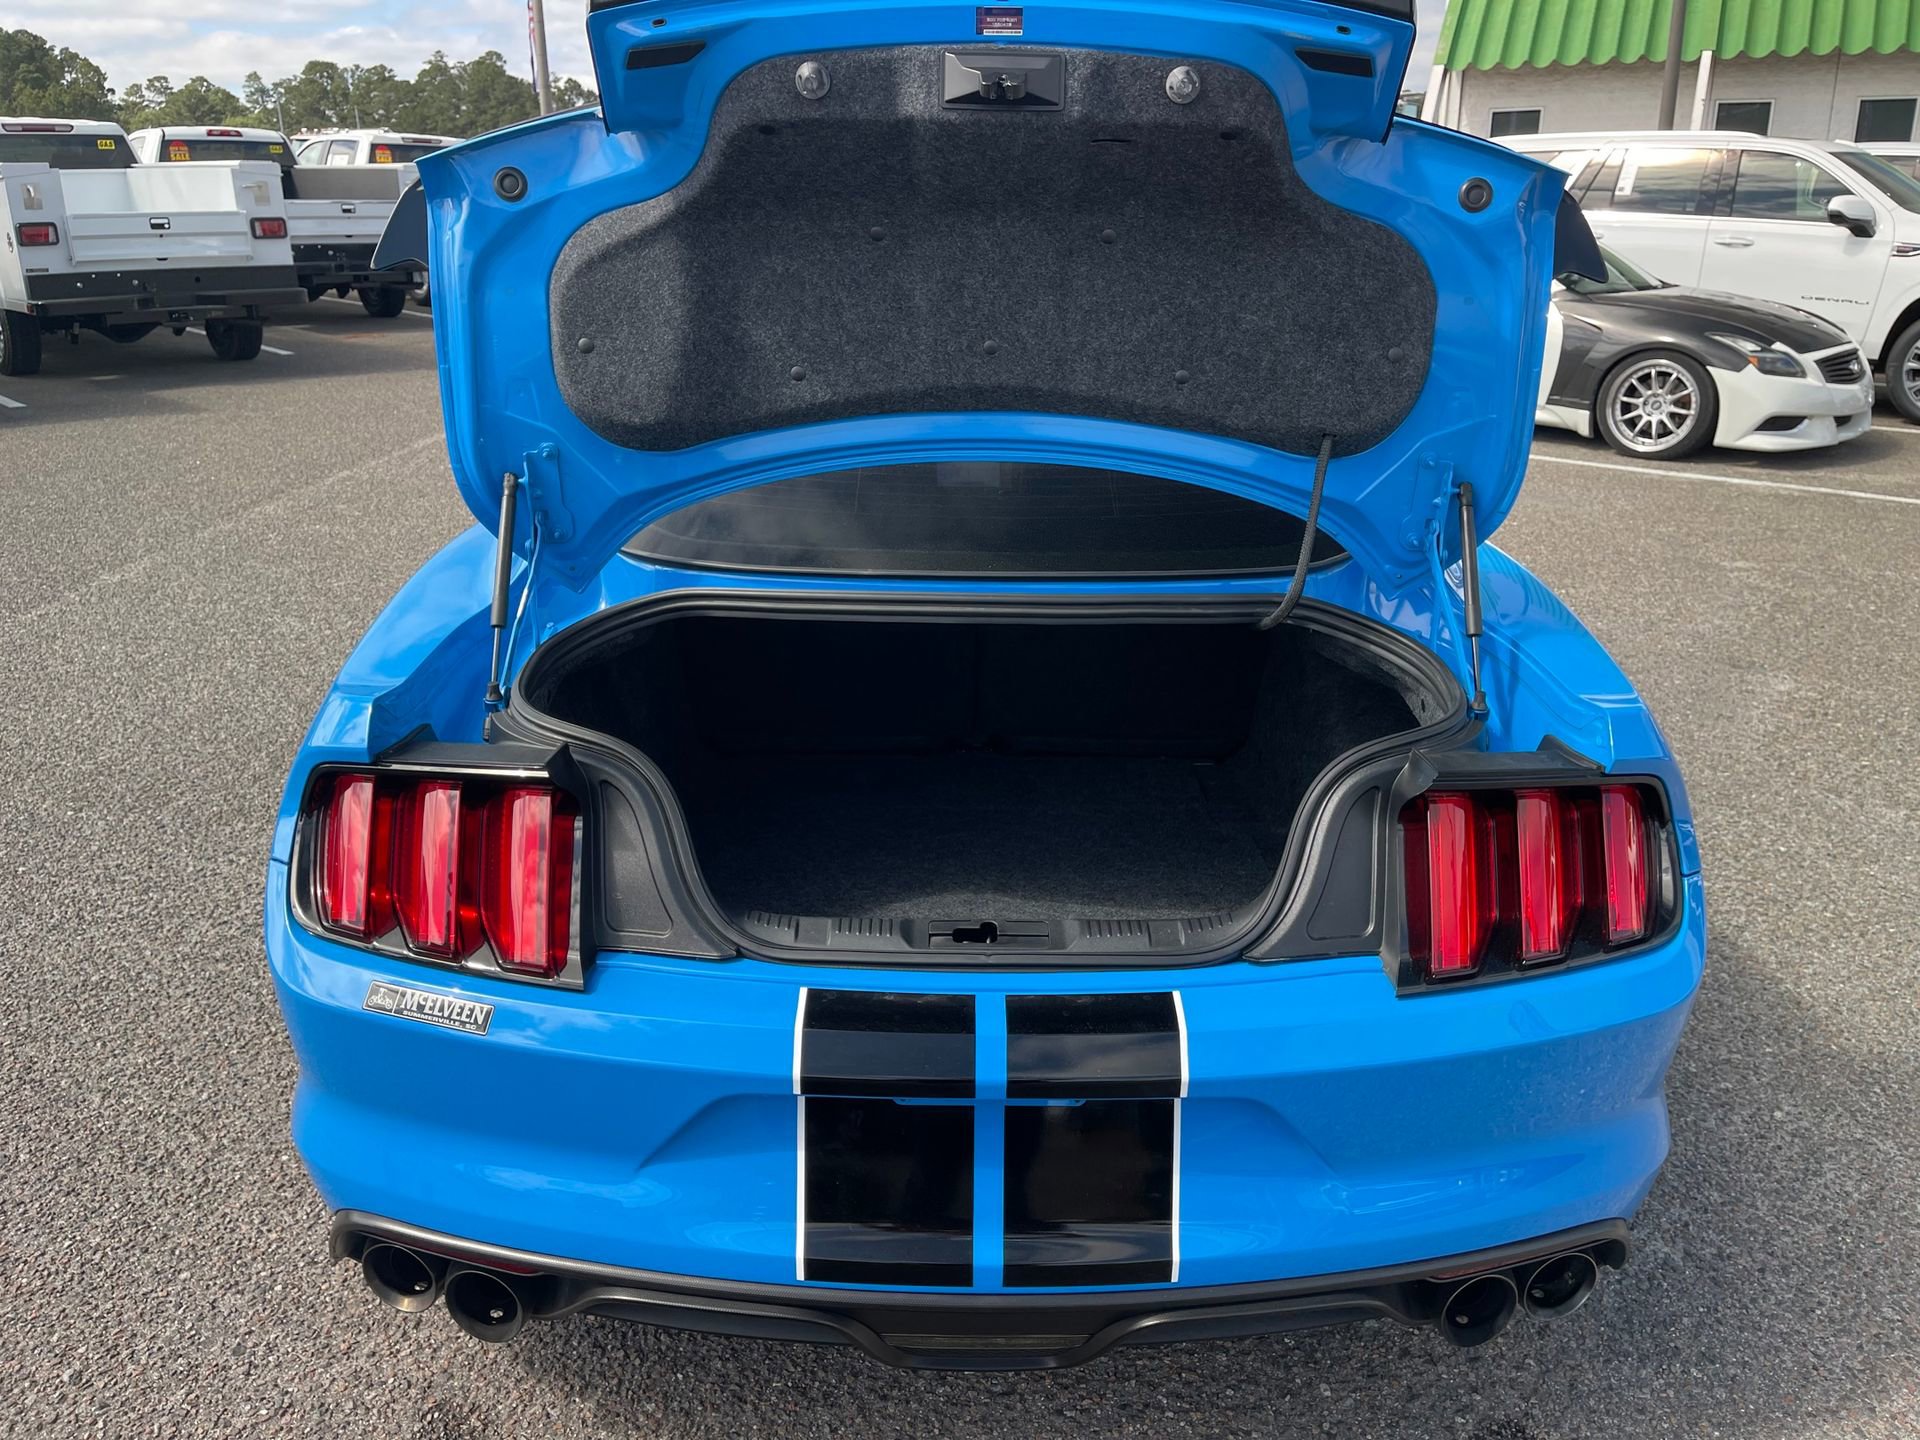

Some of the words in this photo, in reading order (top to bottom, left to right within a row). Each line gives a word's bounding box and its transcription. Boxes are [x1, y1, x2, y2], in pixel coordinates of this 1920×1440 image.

[1800, 295, 1870, 305] DENALI
[402, 1010, 464, 1028] SUMMERVILLE,
[465, 1023, 477, 1031] SC
